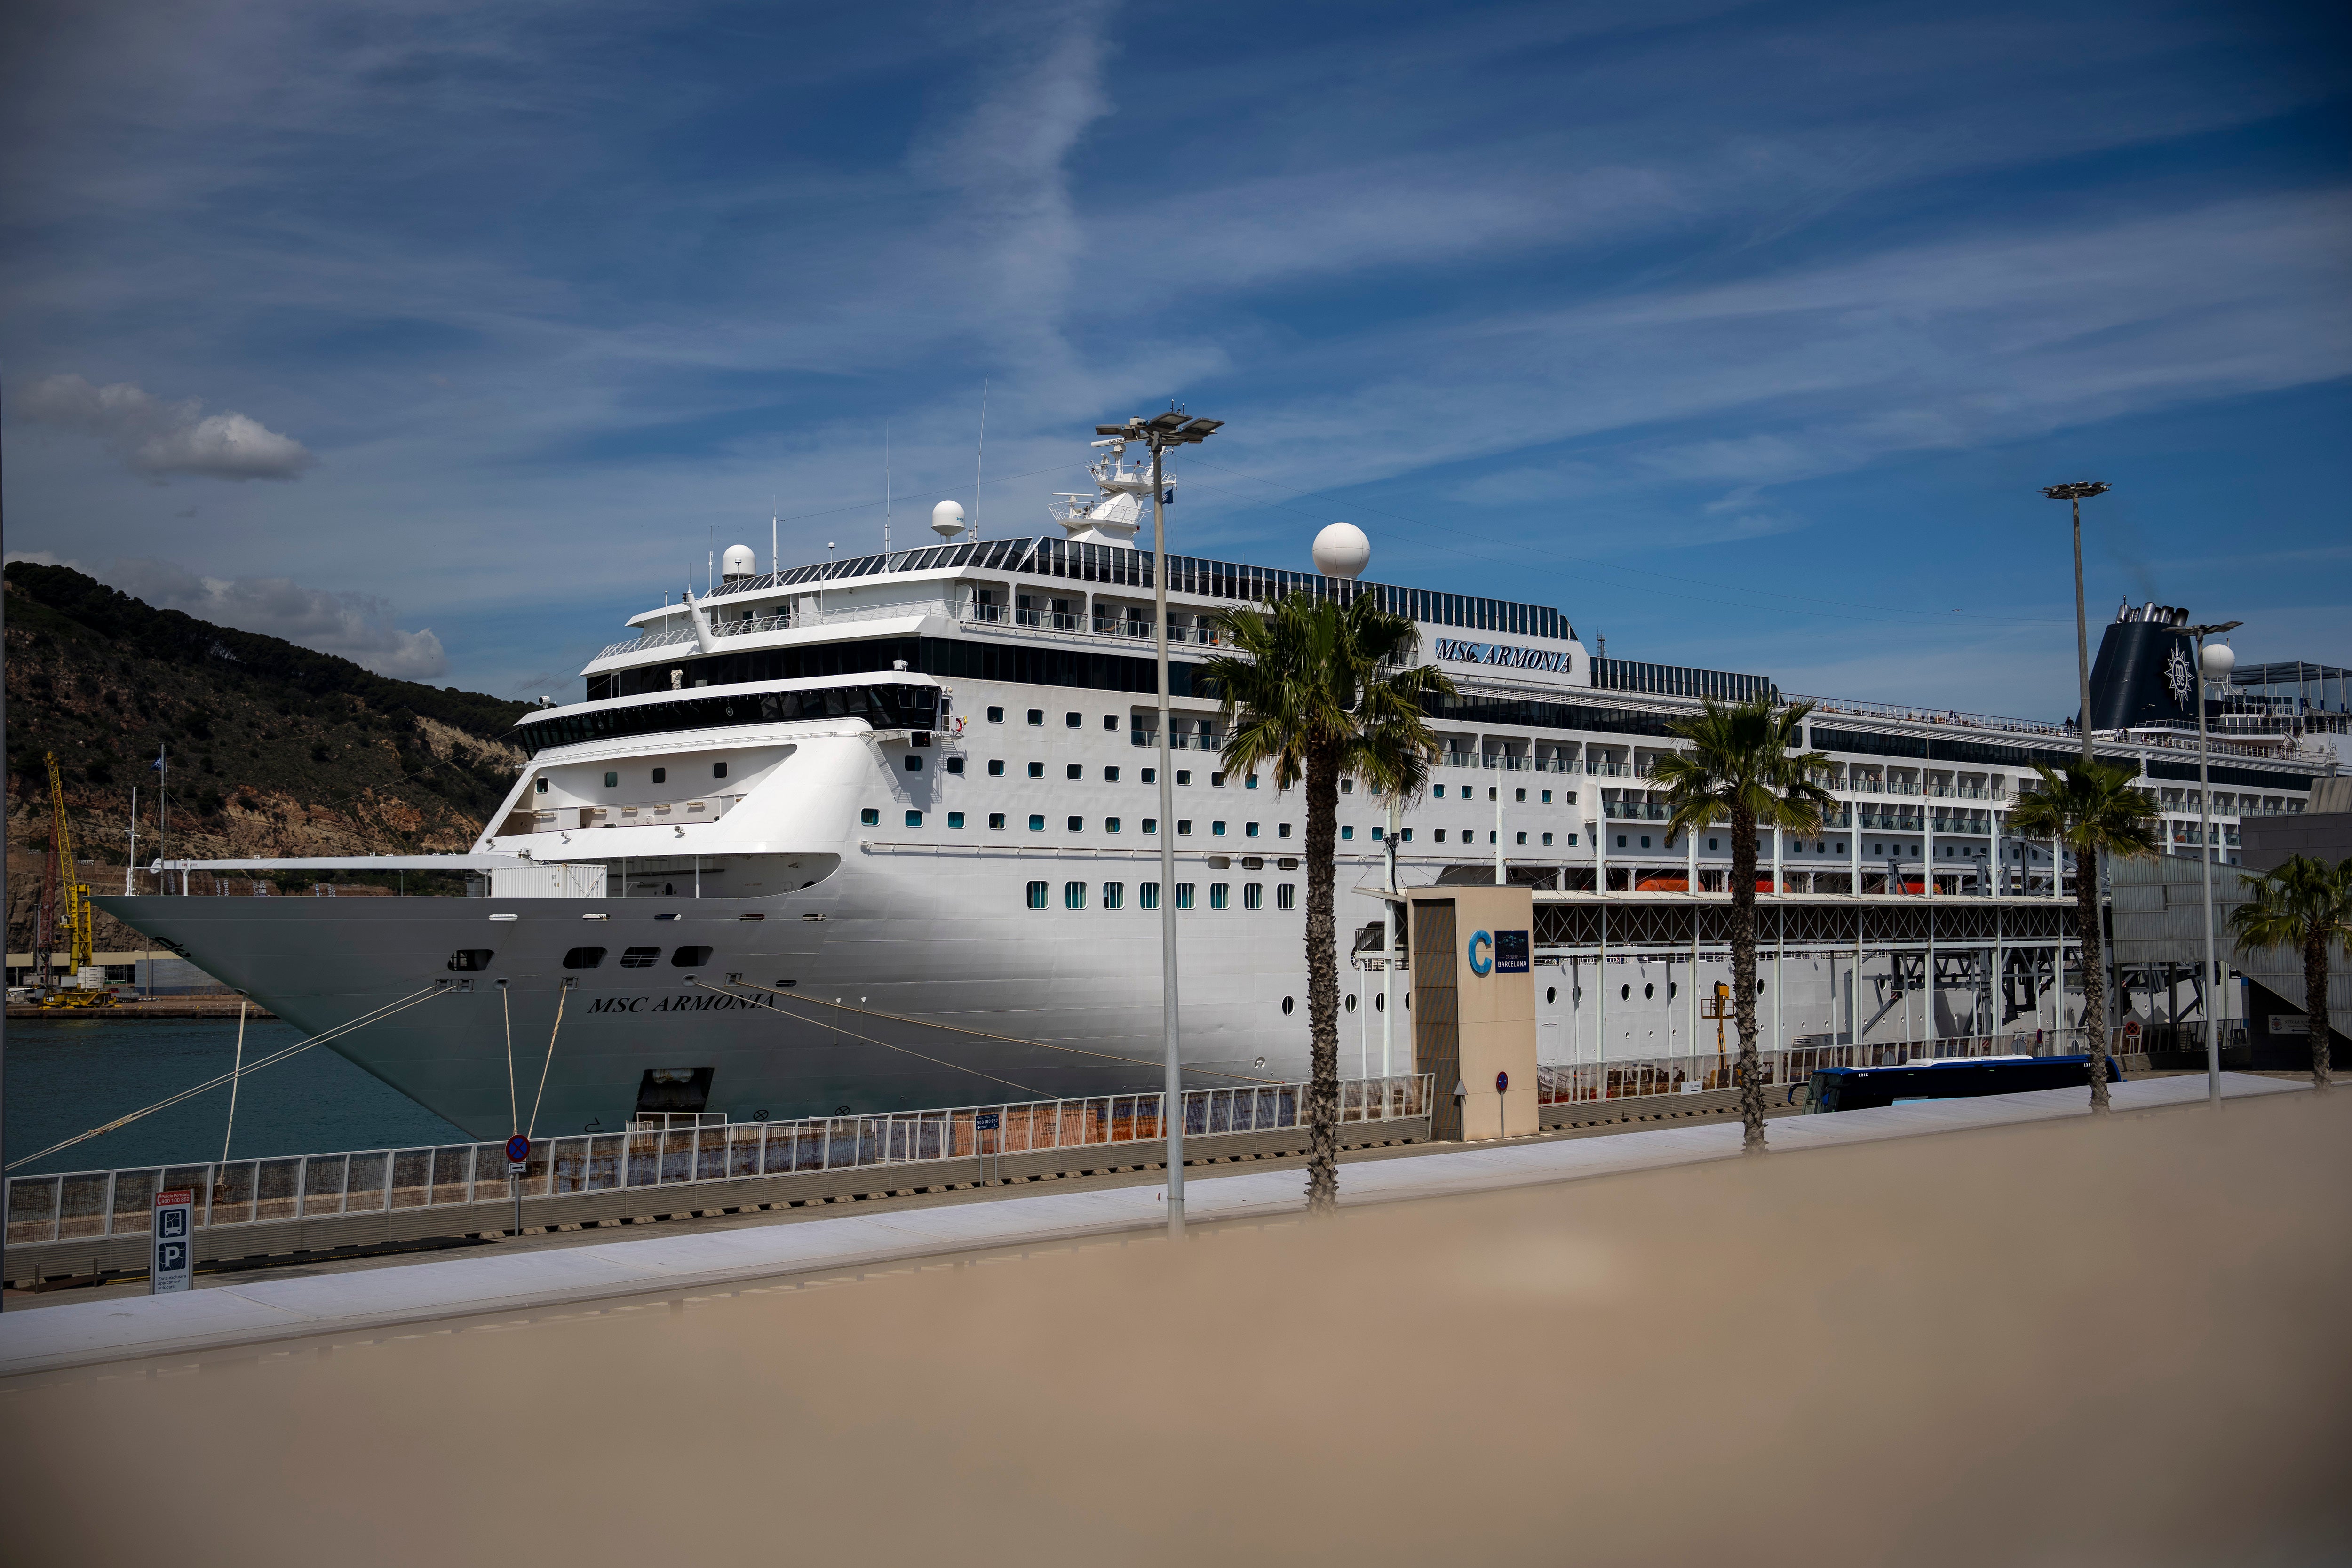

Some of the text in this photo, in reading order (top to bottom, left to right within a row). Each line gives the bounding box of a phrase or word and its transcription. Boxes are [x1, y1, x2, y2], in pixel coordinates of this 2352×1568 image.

[1436, 638, 1572, 673] MSC ARMONIA
[1468, 930, 1493, 974] C
[587, 993, 774, 1013] MSC ARMONIA
[165, 1246, 180, 1267] P
